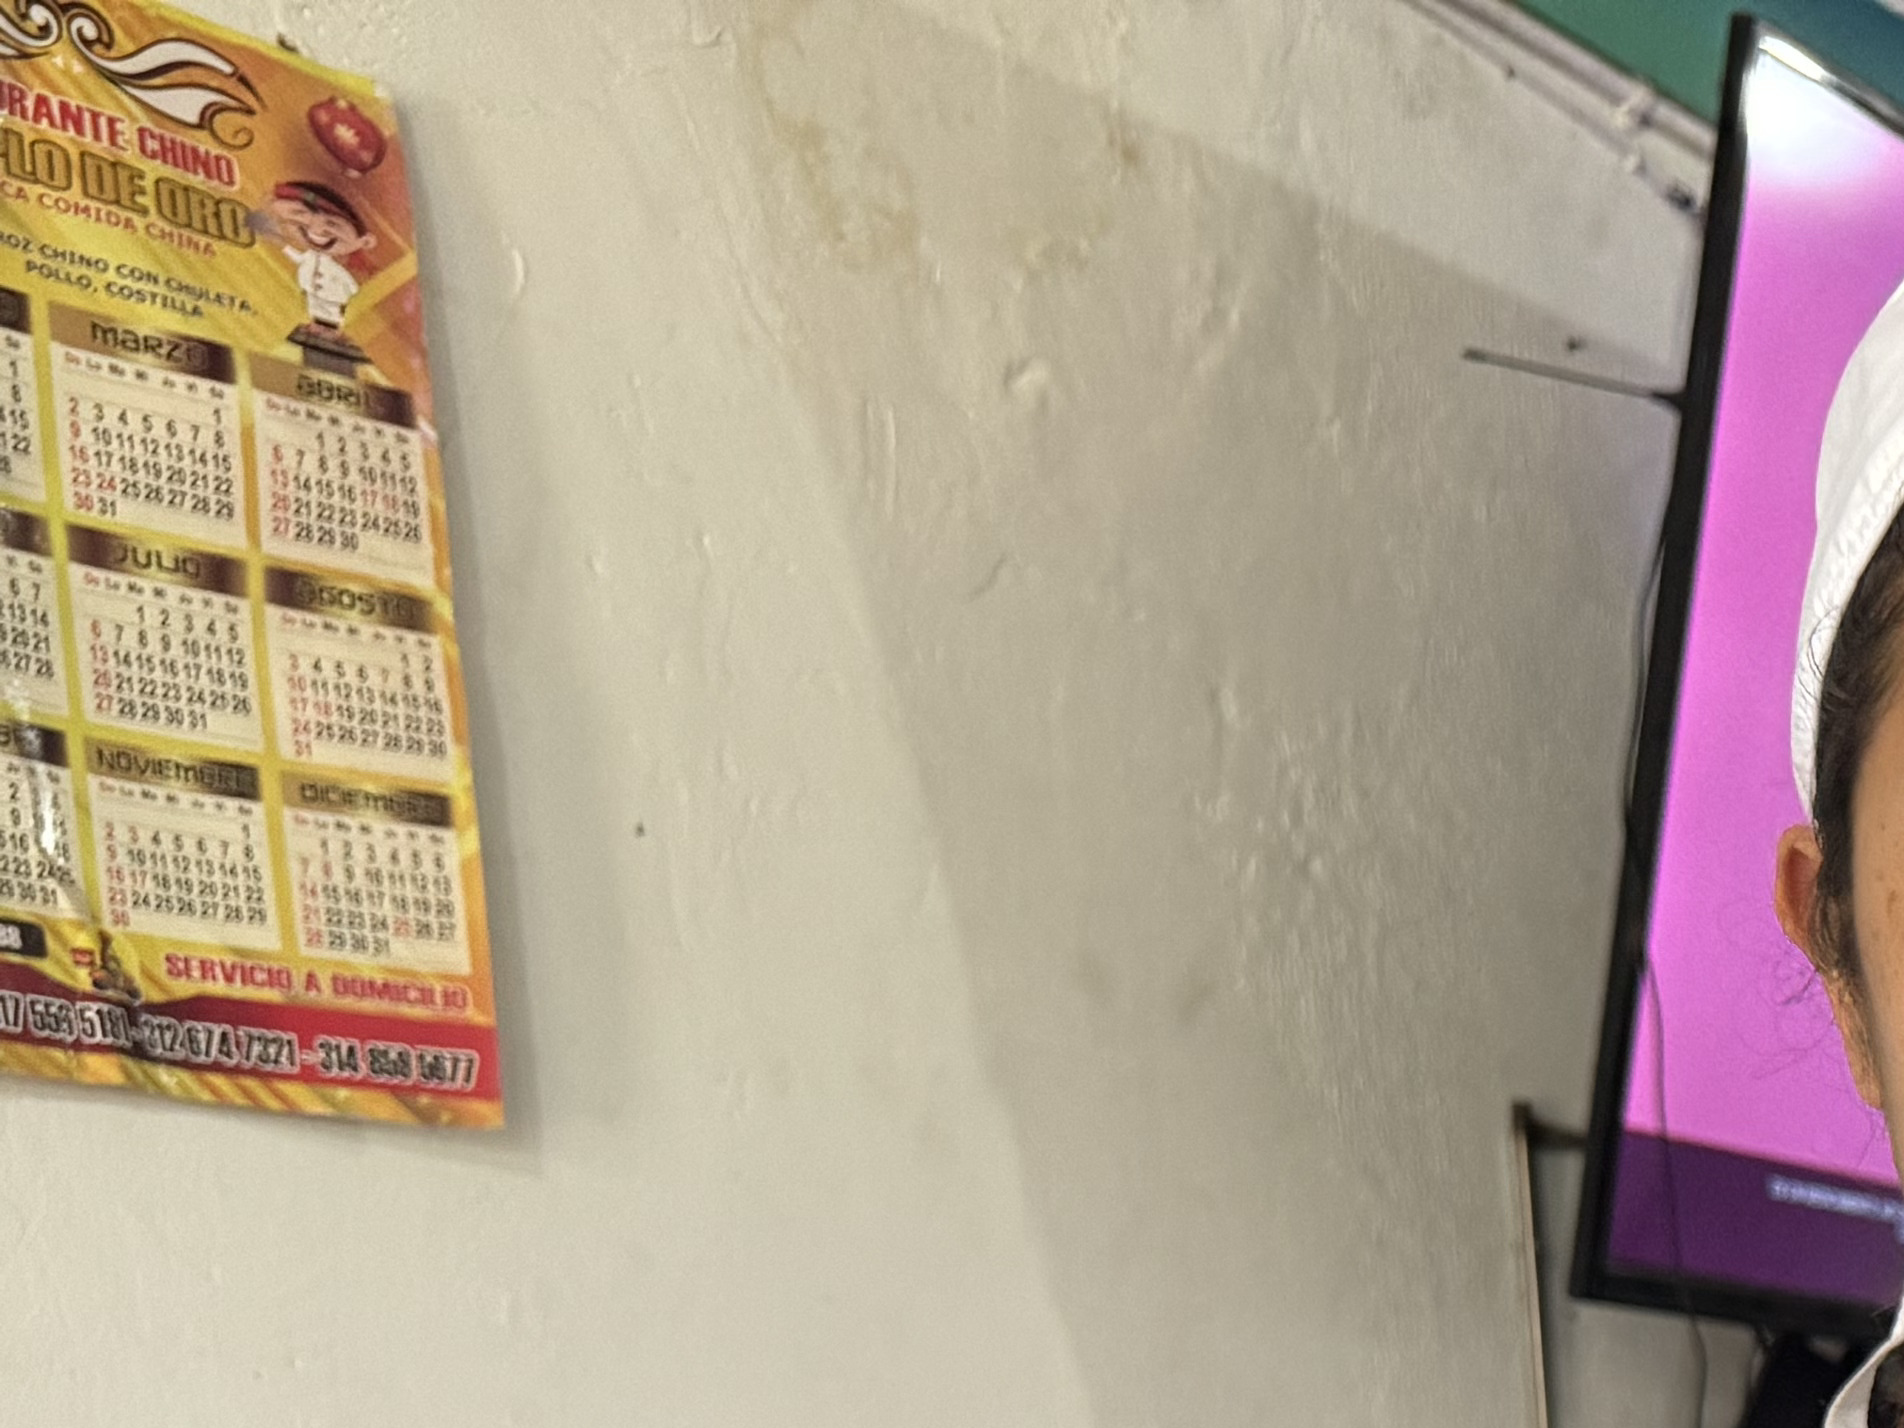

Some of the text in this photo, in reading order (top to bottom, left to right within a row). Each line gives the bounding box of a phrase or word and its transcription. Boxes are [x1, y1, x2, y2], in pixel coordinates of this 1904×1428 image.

[136, 125, 236, 186] CHINO
[39, 193, 136, 235] COMIDA
[146, 222, 216, 257] CHINA
[80, 151, 149, 218] DE
[155, 176, 256, 247] ORO
[40, 244, 109, 273] CHINO
[116, 264, 159, 285] CON
[105, 281, 204, 316] COSTILLA
[165, 953, 467, 1008] SERVICIO A DOMICILIO
